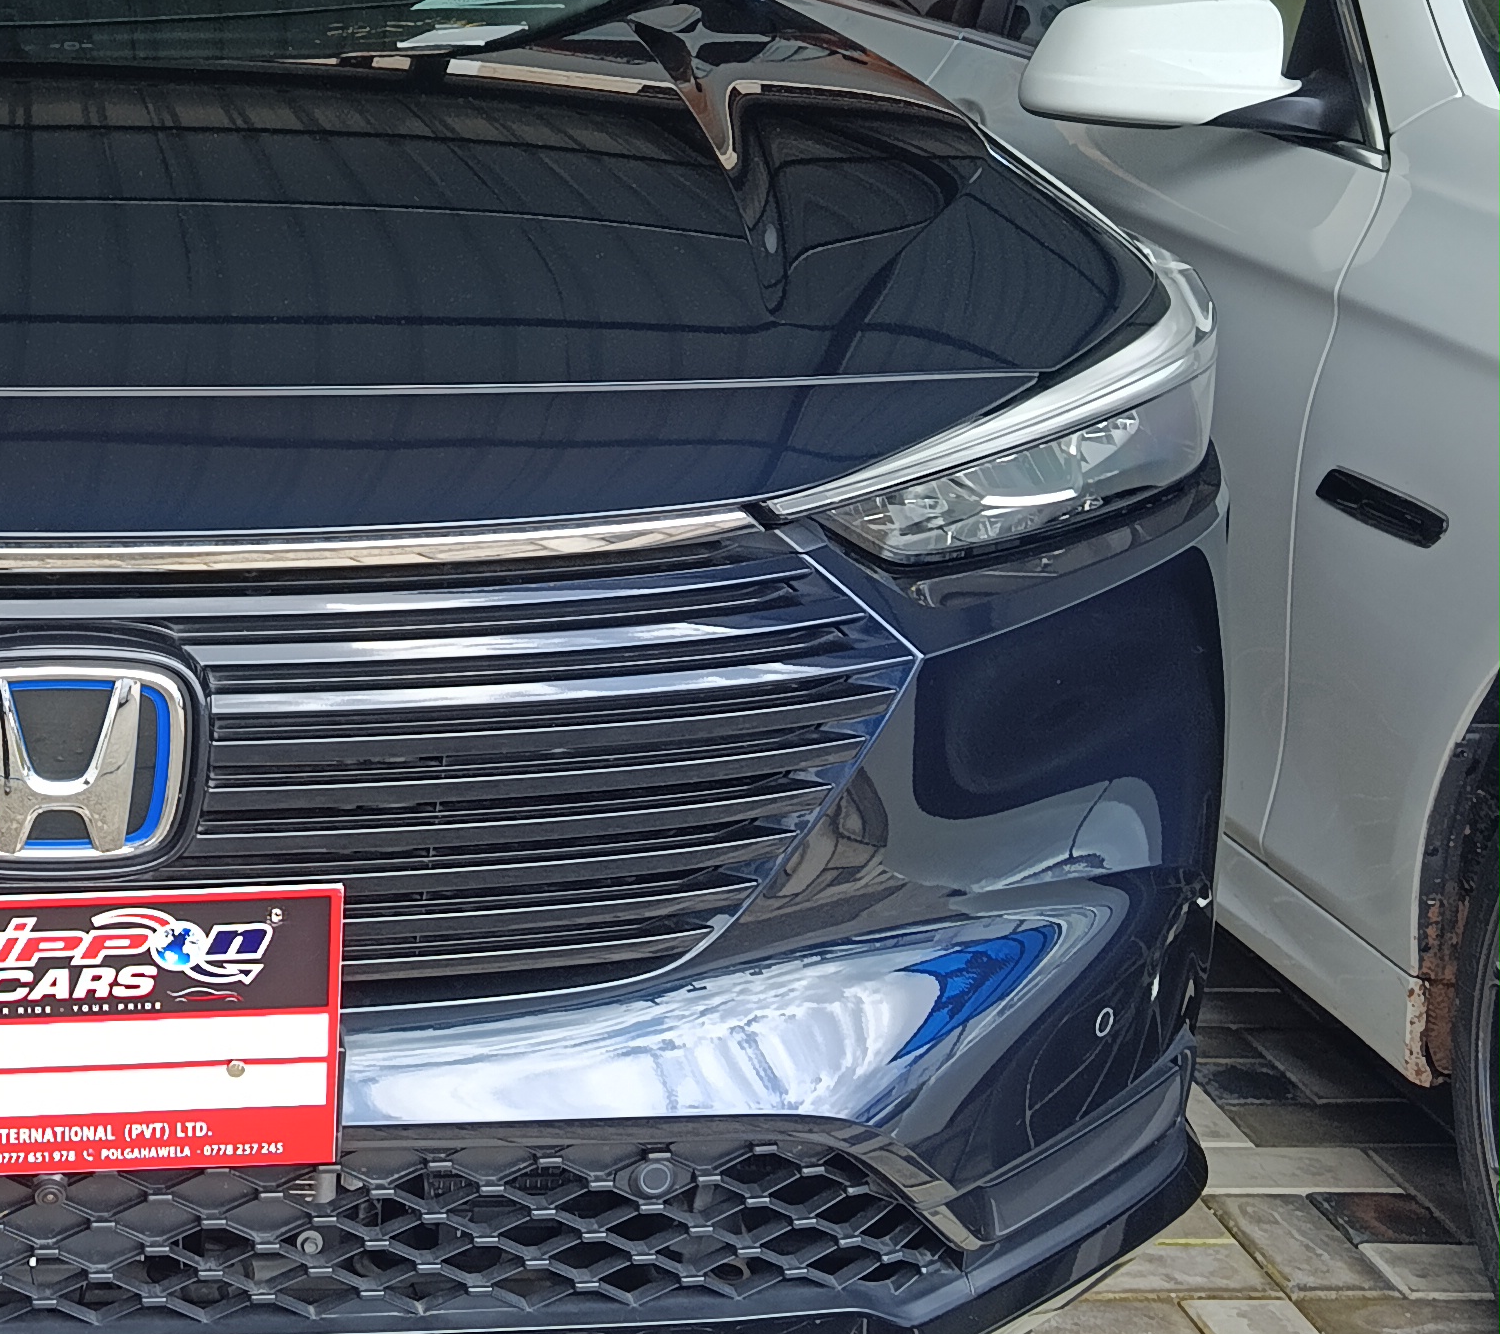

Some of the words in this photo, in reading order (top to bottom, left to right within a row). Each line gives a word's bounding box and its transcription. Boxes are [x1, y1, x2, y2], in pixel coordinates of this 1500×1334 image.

[17, 1005, 52, 1015] RIDE
[72, 1003, 110, 1013] YOUR
[117, 1001, 162, 1012] PRIDE
[124, 1123, 170, 1141] (PVT)
[176, 1121, 213, 1138] LTD.
[27, 1151, 50, 1163] 651
[52, 1150, 77, 1162] 978
[100, 1145, 191, 1160] POLGAHAWELA
[235, 1143, 259, 1155] 257
[261, 1142, 284, 1154] 245
